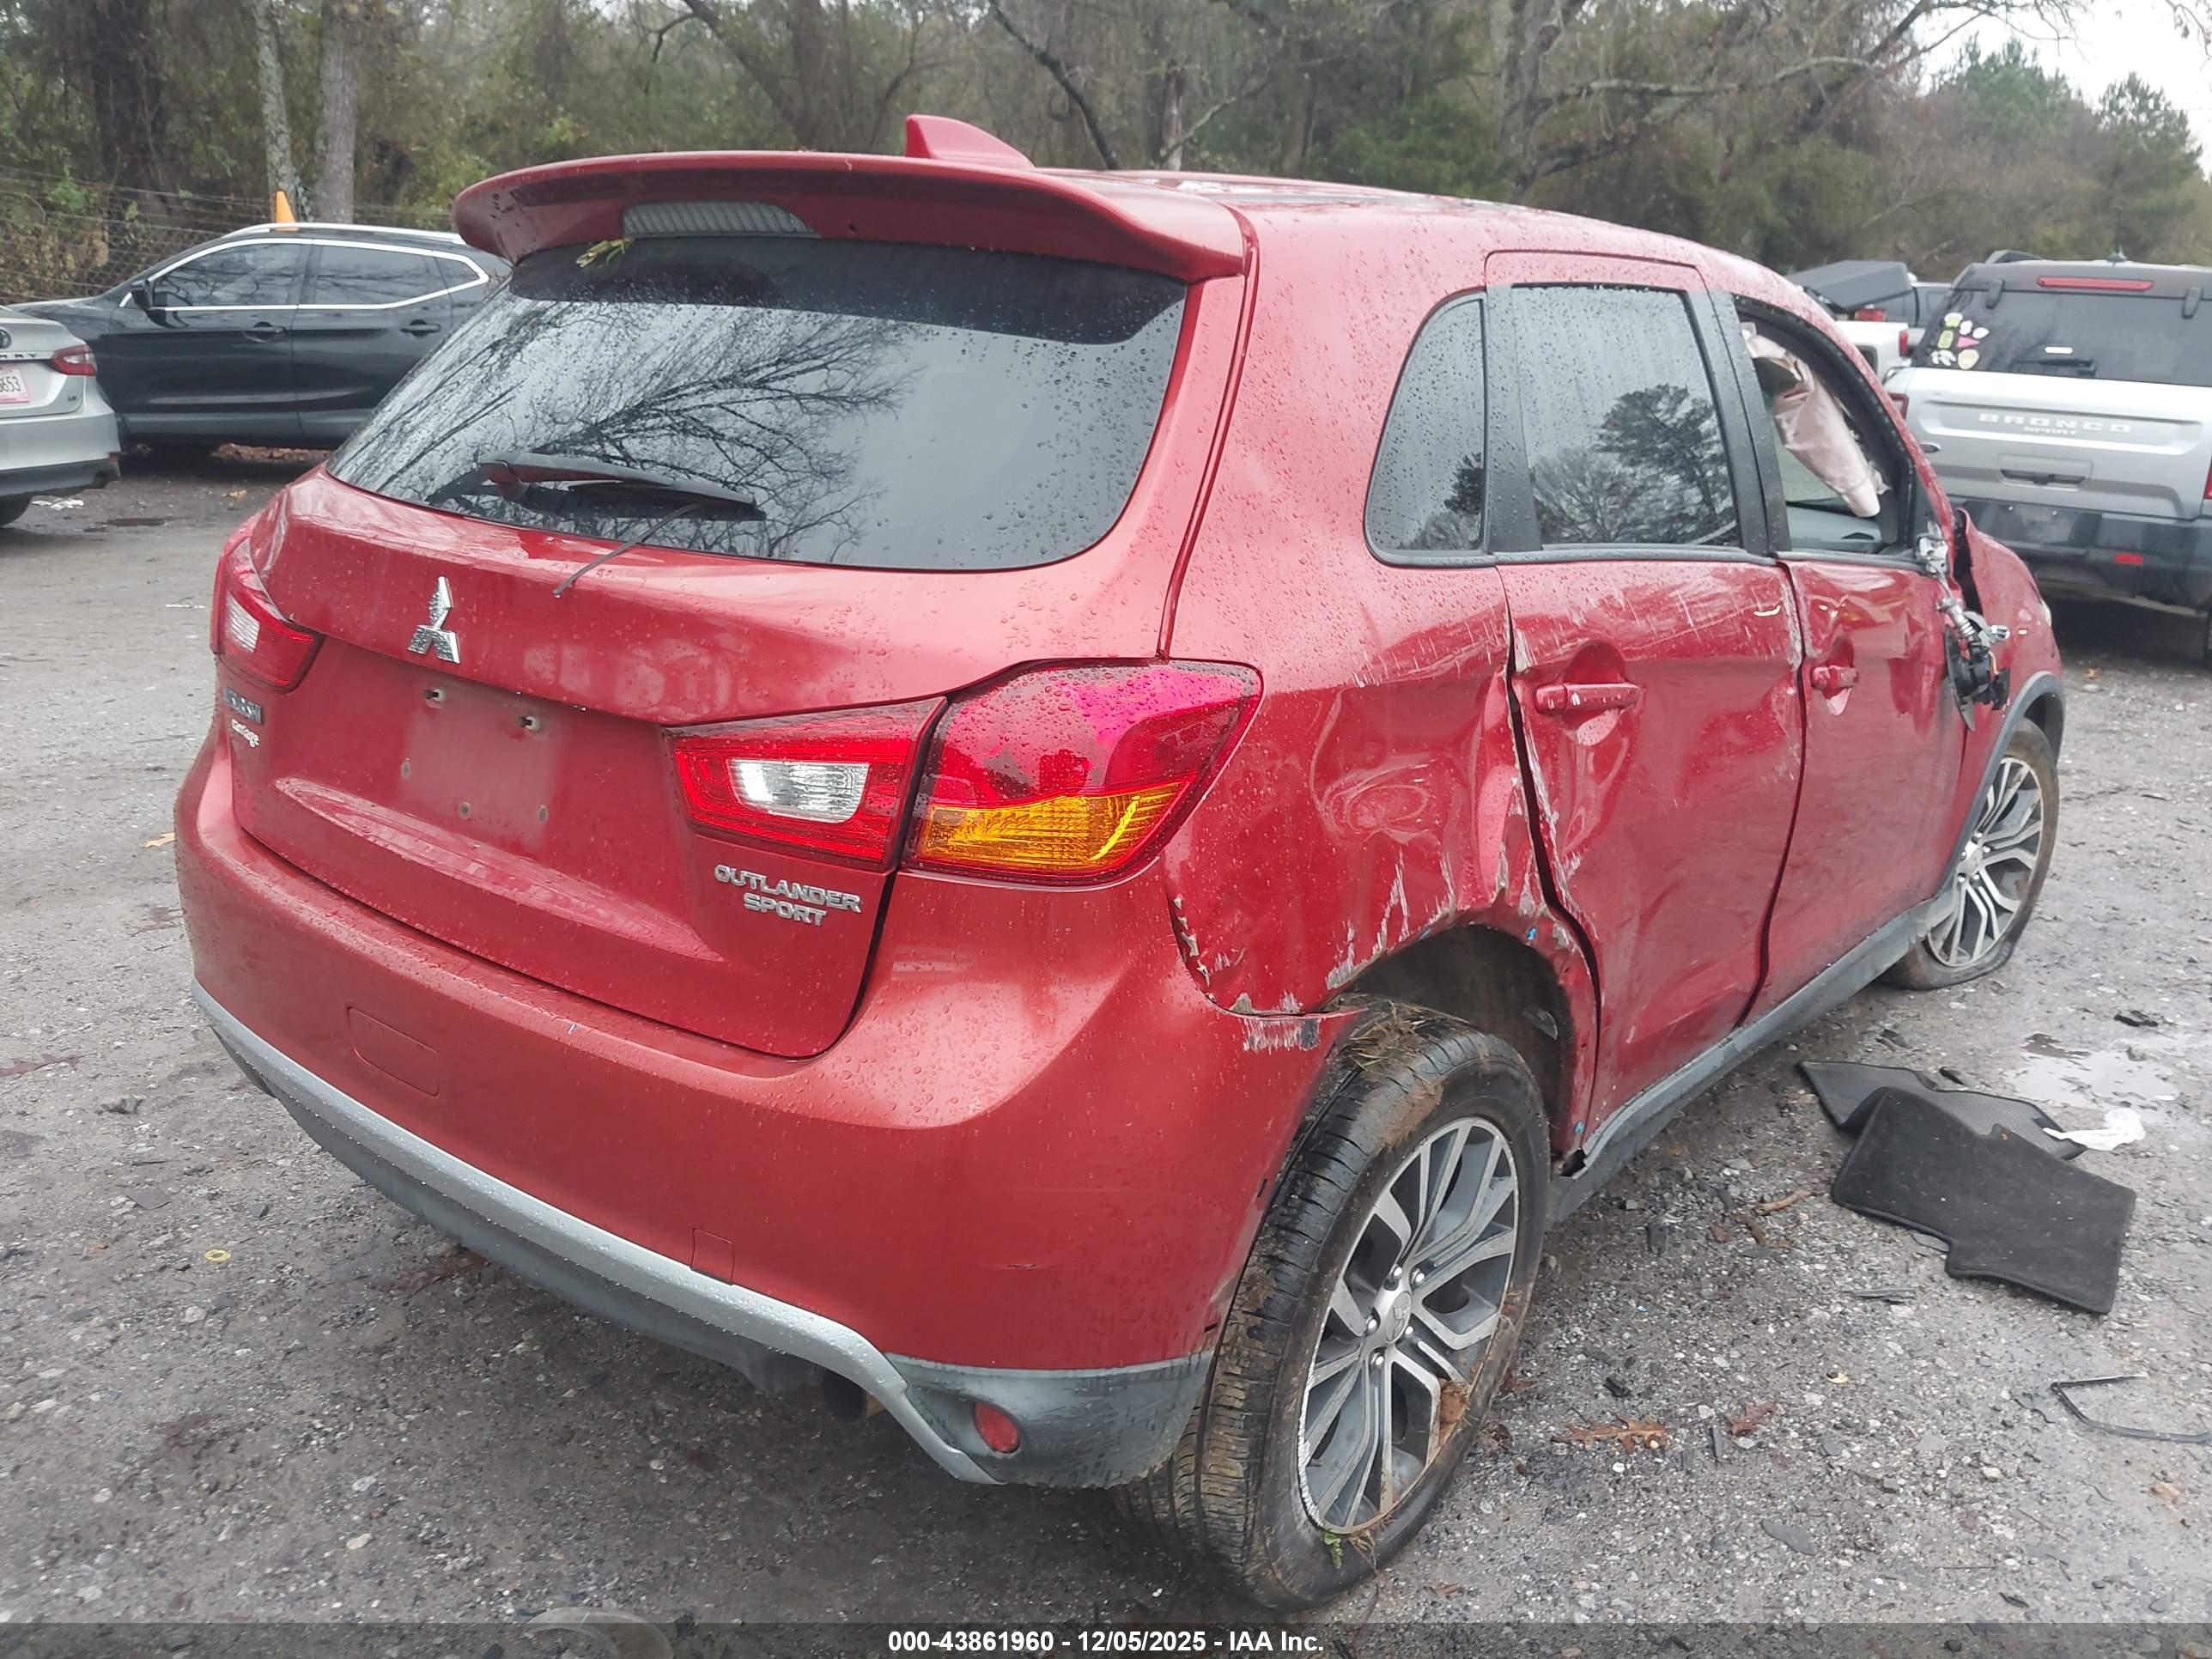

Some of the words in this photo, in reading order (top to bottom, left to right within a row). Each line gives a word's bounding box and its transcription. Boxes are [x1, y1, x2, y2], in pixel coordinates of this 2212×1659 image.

[1978, 413, 2130, 433] BRONCO
[714, 864, 861, 913] OUTLANDER
[744, 892, 827, 926] SPORT
